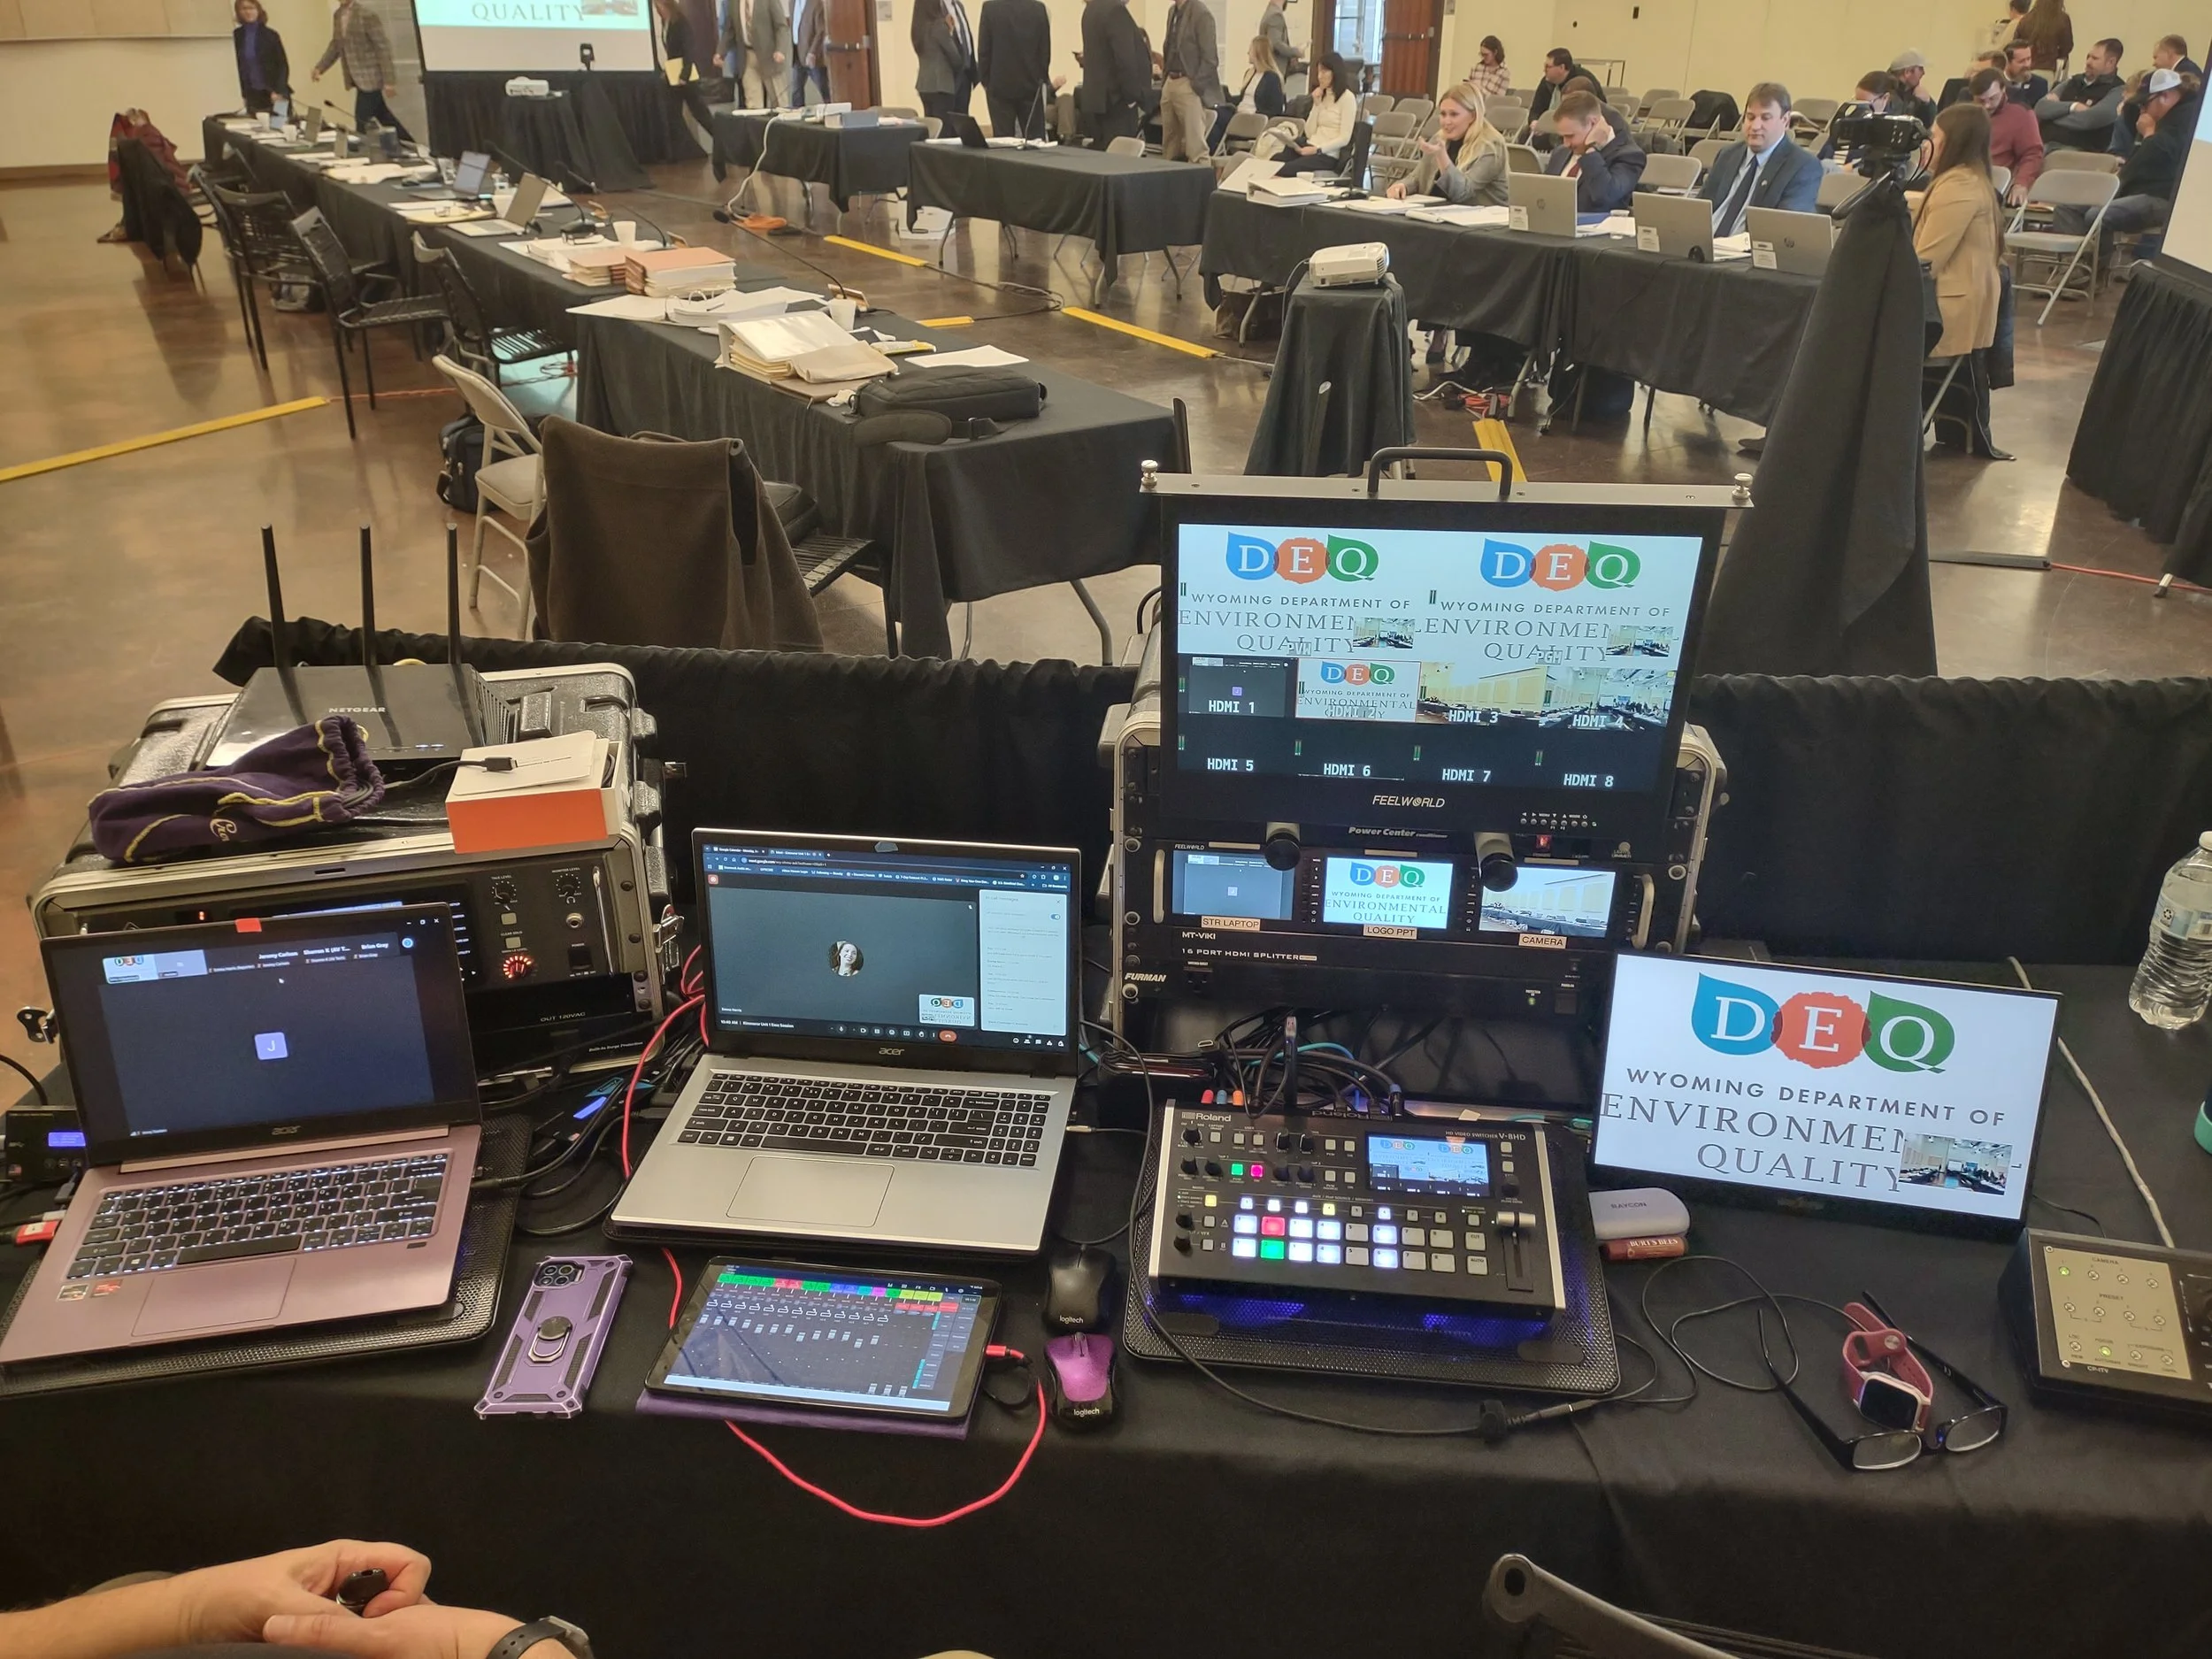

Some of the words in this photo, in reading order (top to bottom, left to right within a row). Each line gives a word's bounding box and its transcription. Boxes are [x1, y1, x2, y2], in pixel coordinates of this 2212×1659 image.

[472, 2, 585, 21] QUALITY
[1238, 545, 1375, 581] DEQ
[1492, 551, 1635, 588] DEQ
[1192, 593, 1272, 605] WYOMING
[1280, 596, 1382, 609] DEPARTMENT
[1390, 600, 1410, 610] OF
[1440, 601, 1525, 613] WYOMING
[1533, 603, 1640, 616] DEPARTMENT
[1648, 607, 1671, 617] OF
[1327, 666, 1392, 684] DEQ
[1208, 700, 1240, 713] HDMI
[1248, 702, 1255, 714] 1
[1298, 697, 1416, 710] ENVIRONMENTAL
[1328, 706, 1358, 718] HDMI
[1369, 707, 1376, 718] 2
[1448, 710, 1481, 723] HDMI
[1490, 711, 1498, 724] 3
[1572, 714, 1607, 727] HDMI
[1614, 716, 1624, 728] 4
[1207, 757, 1238, 771] HDMI
[1246, 759, 1254, 772] 5
[1324, 764, 1355, 776] HDMI
[1363, 764, 1371, 777] 6
[1442, 768, 1474, 782] HDMI
[1483, 770, 1491, 782] 7
[1563, 773, 1597, 787] HDMI
[1604, 775, 1614, 787] 8
[1372, 795, 1445, 808] FEELWORLD
[1348, 826, 1381, 838] Power
[1383, 827, 1416, 837] Center
[1356, 867, 1423, 887] DEQ
[1325, 898, 1447, 914] ENVIRONMENTAL
[1223, 919, 1260, 928] LAPTOP
[1353, 912, 1416, 924] QUALITY
[1182, 931, 1216, 940] MT-VIKI
[1367, 926, 1394, 935] LOGO
[1522, 936, 1563, 947] CAMERA
[1253, 952, 1299, 961] SPLITTER
[1125, 972, 1167, 983] FURMAN
[1710, 996, 1946, 1073] DEQ
[879, 1047, 905, 1056] acer
[1627, 1067, 1764, 1098] WYOMING
[1778, 1086, 1955, 1121] DEPARTMENT
[1970, 1110, 2005, 1126] OF
[1195, 1112, 1232, 1122] Roland
[272, 1125, 301, 1135] acer
[1698, 1142, 1901, 1193] QUALITY
[2093, 1256, 2119, 1265] CAMERA
[1059, 1315, 1084, 1325] logitech
[1073, 1407, 1100, 1417] logitech
